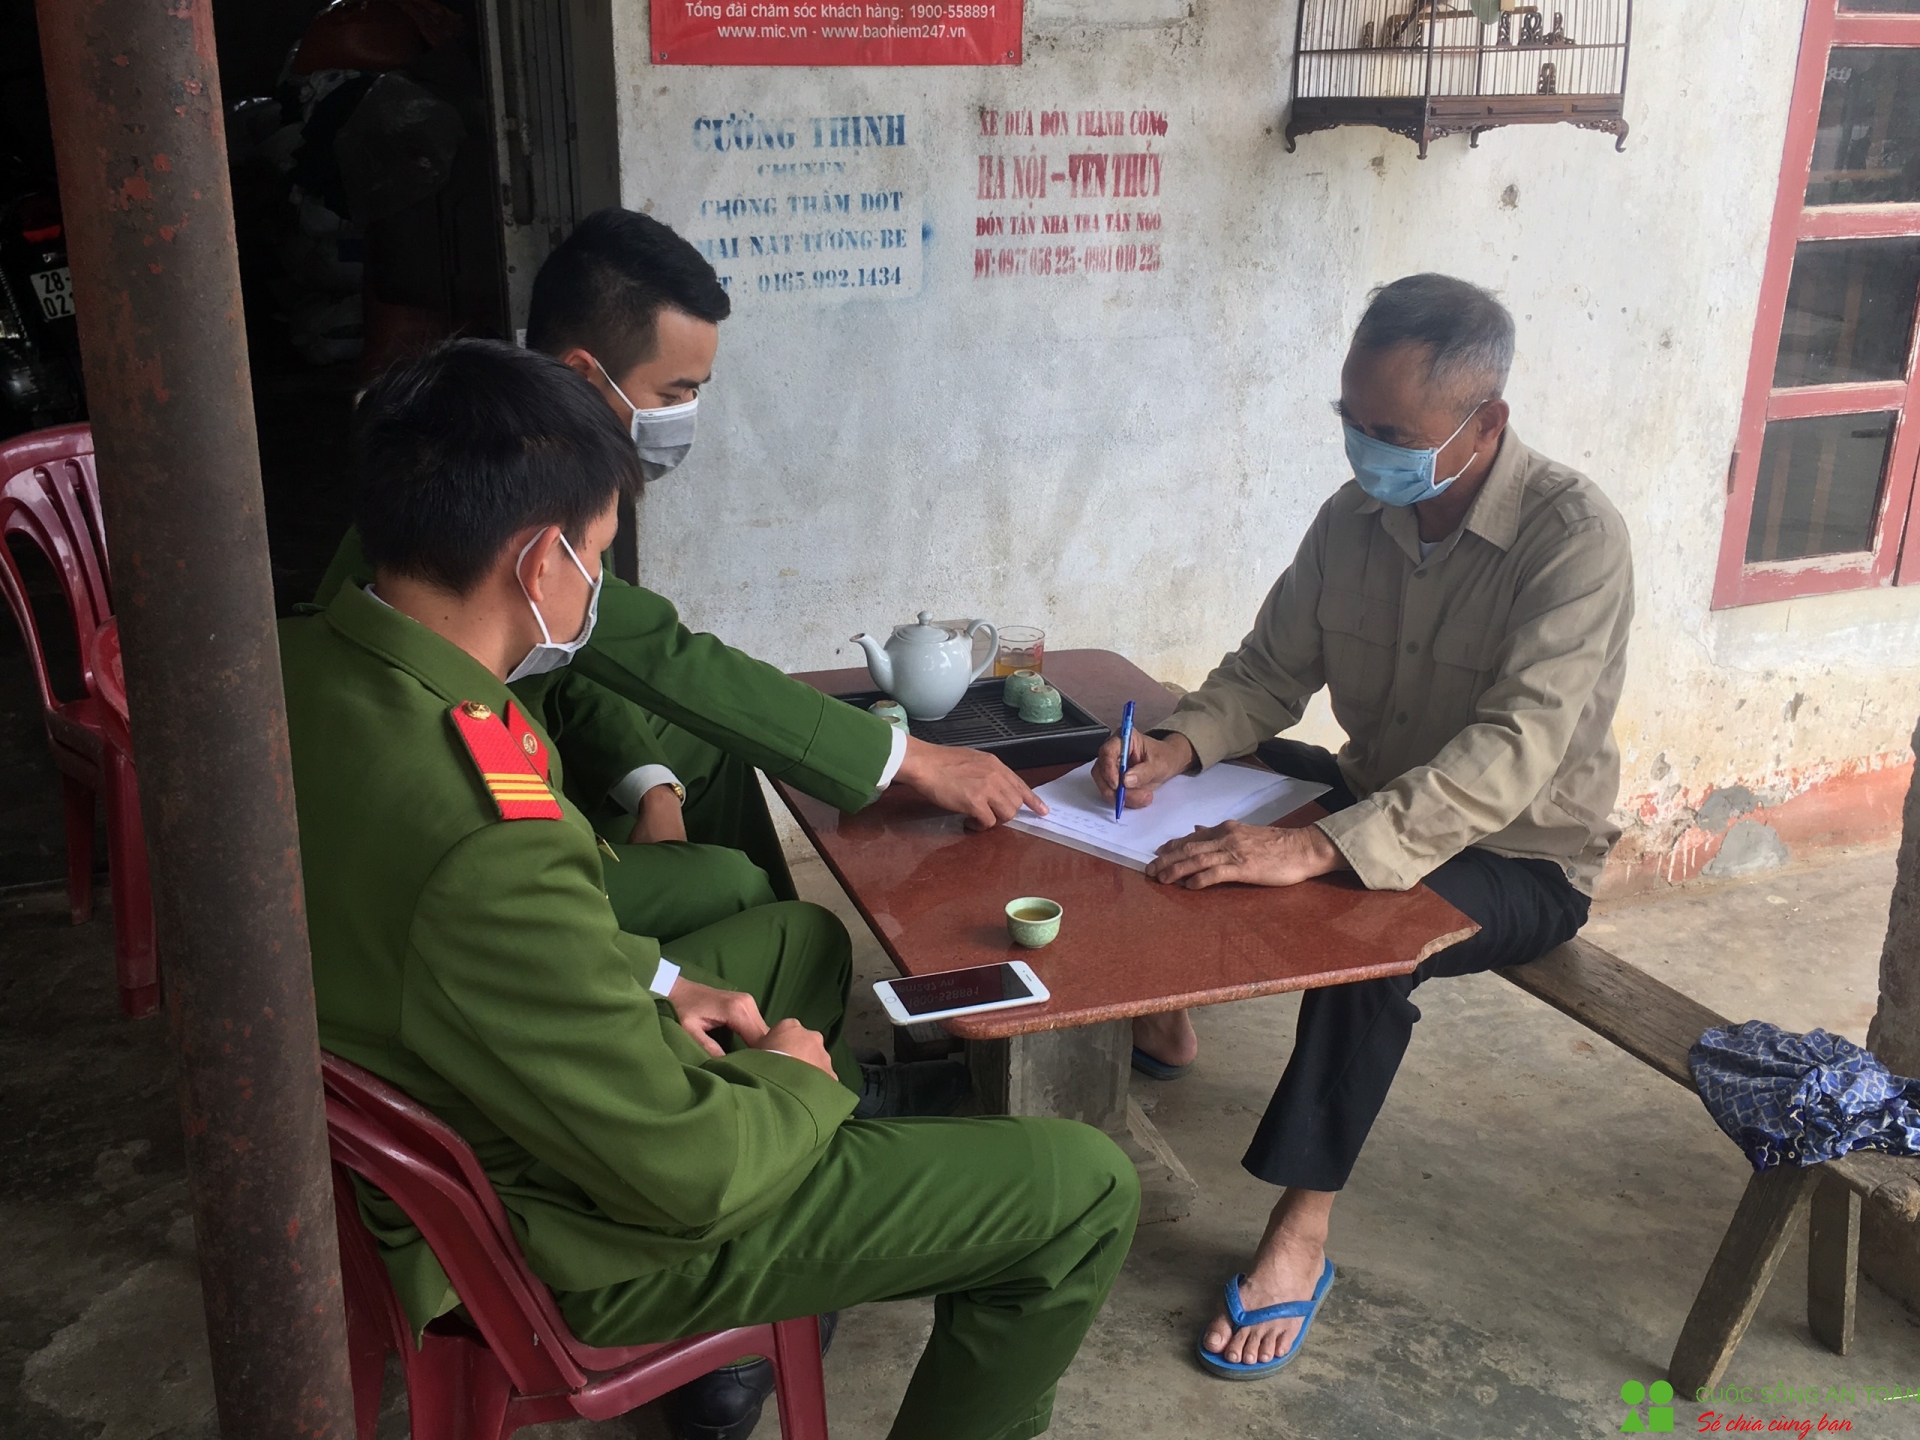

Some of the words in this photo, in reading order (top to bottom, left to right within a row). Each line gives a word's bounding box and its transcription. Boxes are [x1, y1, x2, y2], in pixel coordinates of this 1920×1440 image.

[685, 1, 722, 20] Tổng
[726, 2, 747, 18] đài
[750, 3, 790, 18] chăm
[793, 3, 817, 18] sóc
[820, 4, 862, 19] khách
[866, 3, 904, 21] hàng:
[909, 4, 996, 19] 1900-558891
[717, 24, 808, 38] www.mic.vn
[821, 24, 966, 39] www.baohiem247.vn
[43, 291, 74, 318] 02
